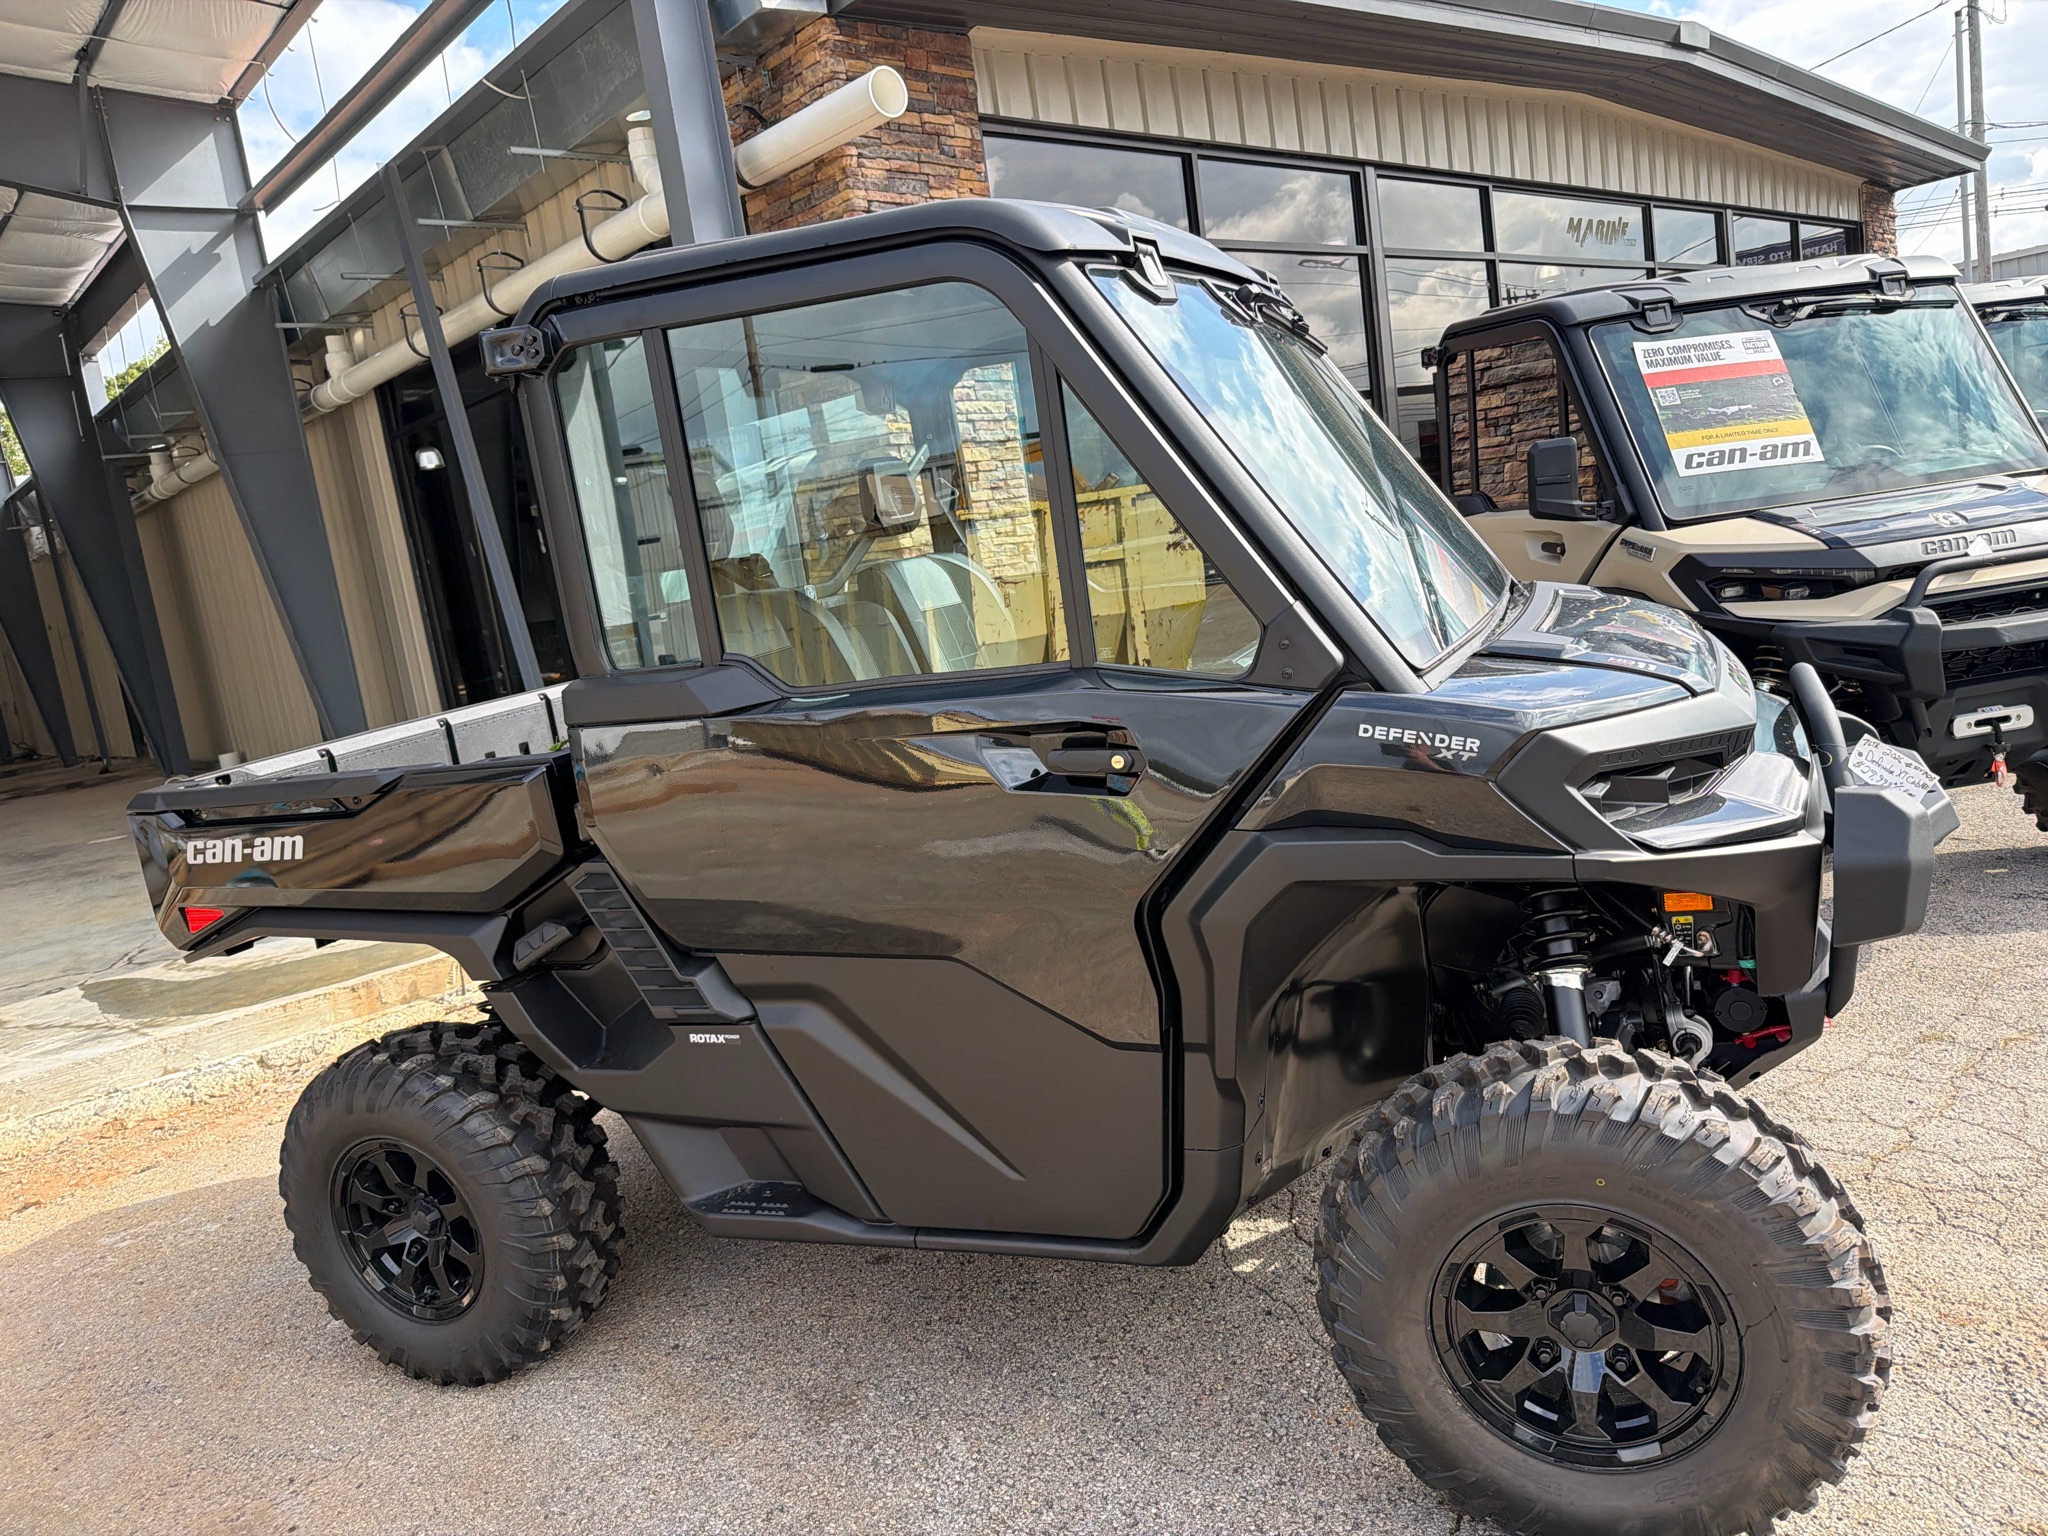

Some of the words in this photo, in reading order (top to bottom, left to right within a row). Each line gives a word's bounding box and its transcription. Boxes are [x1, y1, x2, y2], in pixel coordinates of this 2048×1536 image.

[1566, 216, 1629, 248] MARINE
[1641, 347, 1665, 359] ZERO
[1666, 340, 1735, 356] COMPROMISES.
[1743, 341, 1769, 350] FACTORY
[1645, 354, 1694, 369] MAXIMUM
[1694, 351, 1726, 363] VALUE.
[1720, 431, 1747, 439] LIMITED
[1684, 439, 1812, 470] can-am
[1358, 723, 1481, 752] DEFENDER
[1431, 748, 1478, 761] XT
[186, 834, 304, 865] can-am
[689, 1033, 726, 1043] ROTAX
